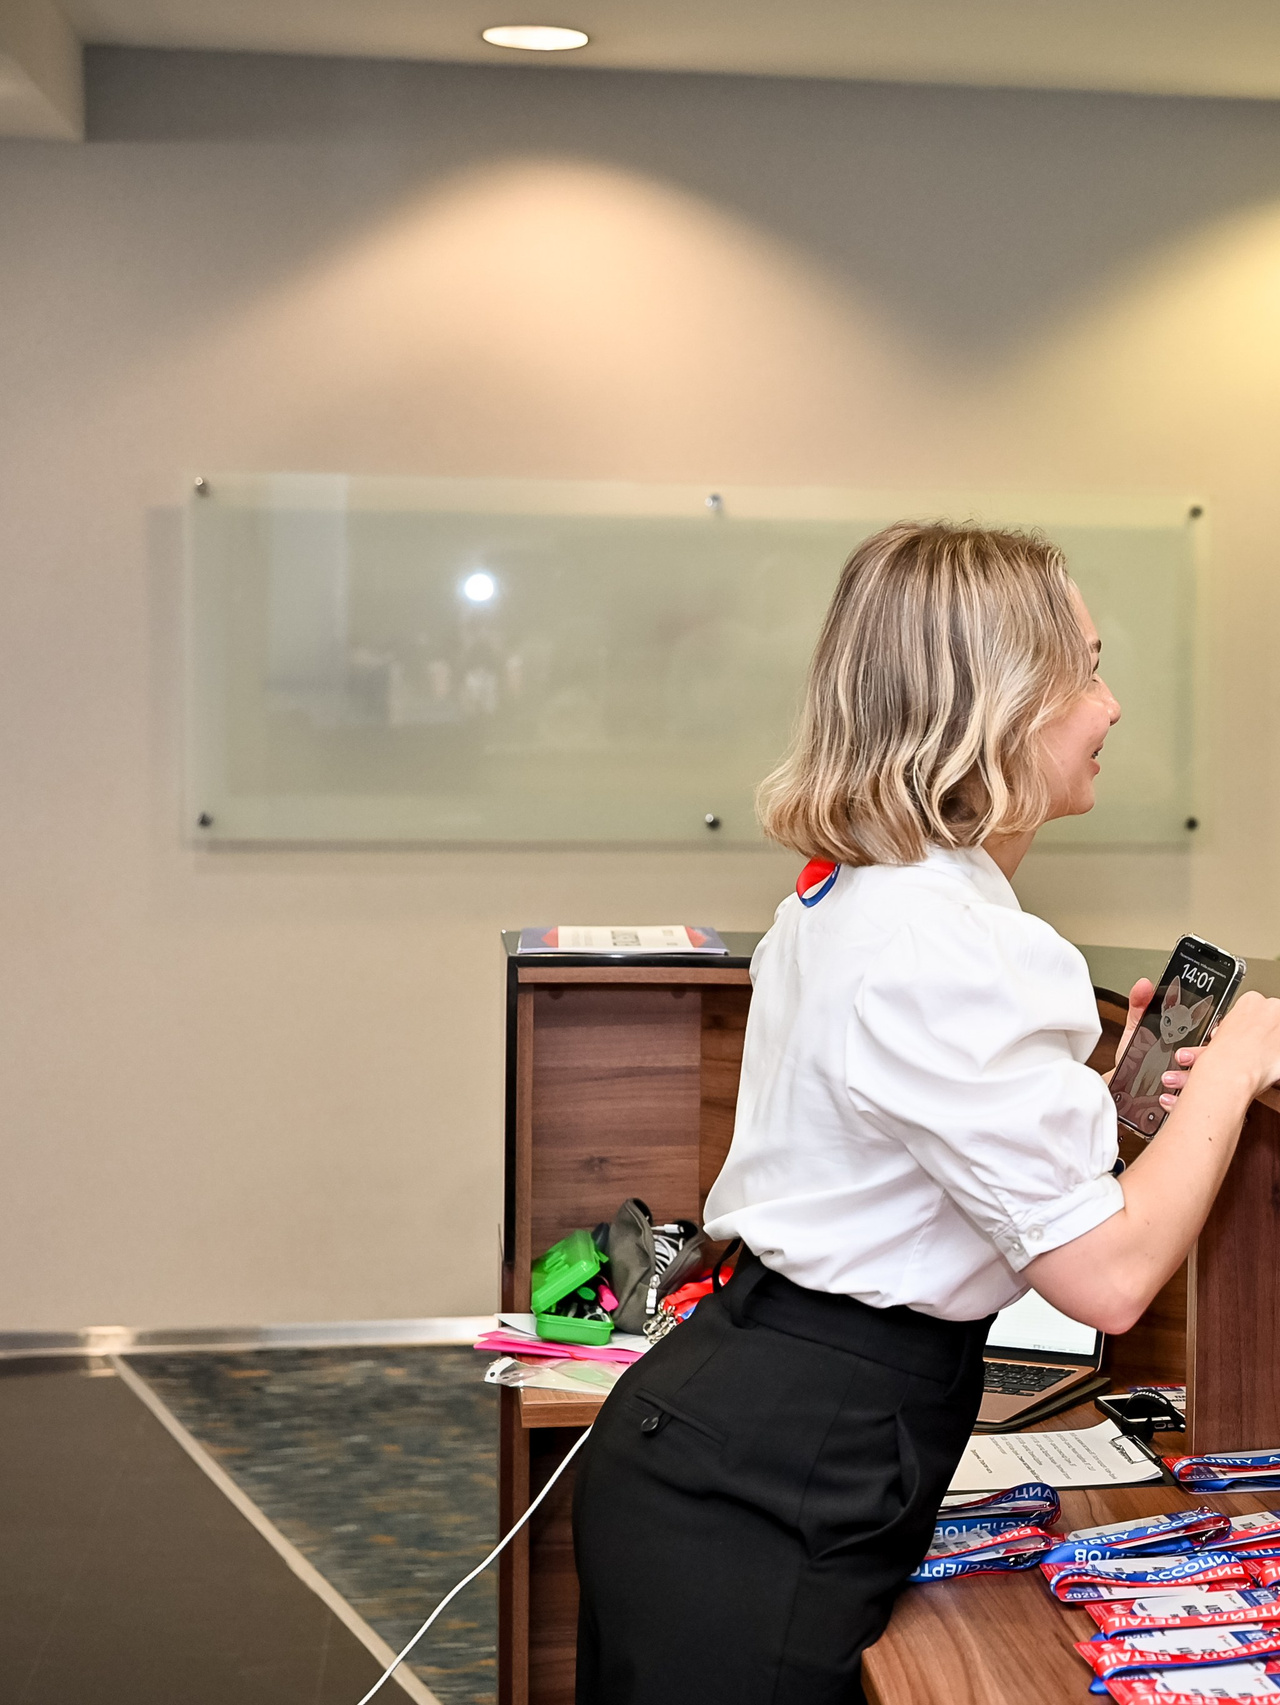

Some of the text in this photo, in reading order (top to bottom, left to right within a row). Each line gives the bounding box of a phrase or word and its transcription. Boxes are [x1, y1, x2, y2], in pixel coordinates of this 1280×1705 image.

[1181, 963, 1215, 992] 14:01
[1108, 1617, 1181, 1627] RETAIL
[1098, 1651, 1172, 1666] RETAIL
